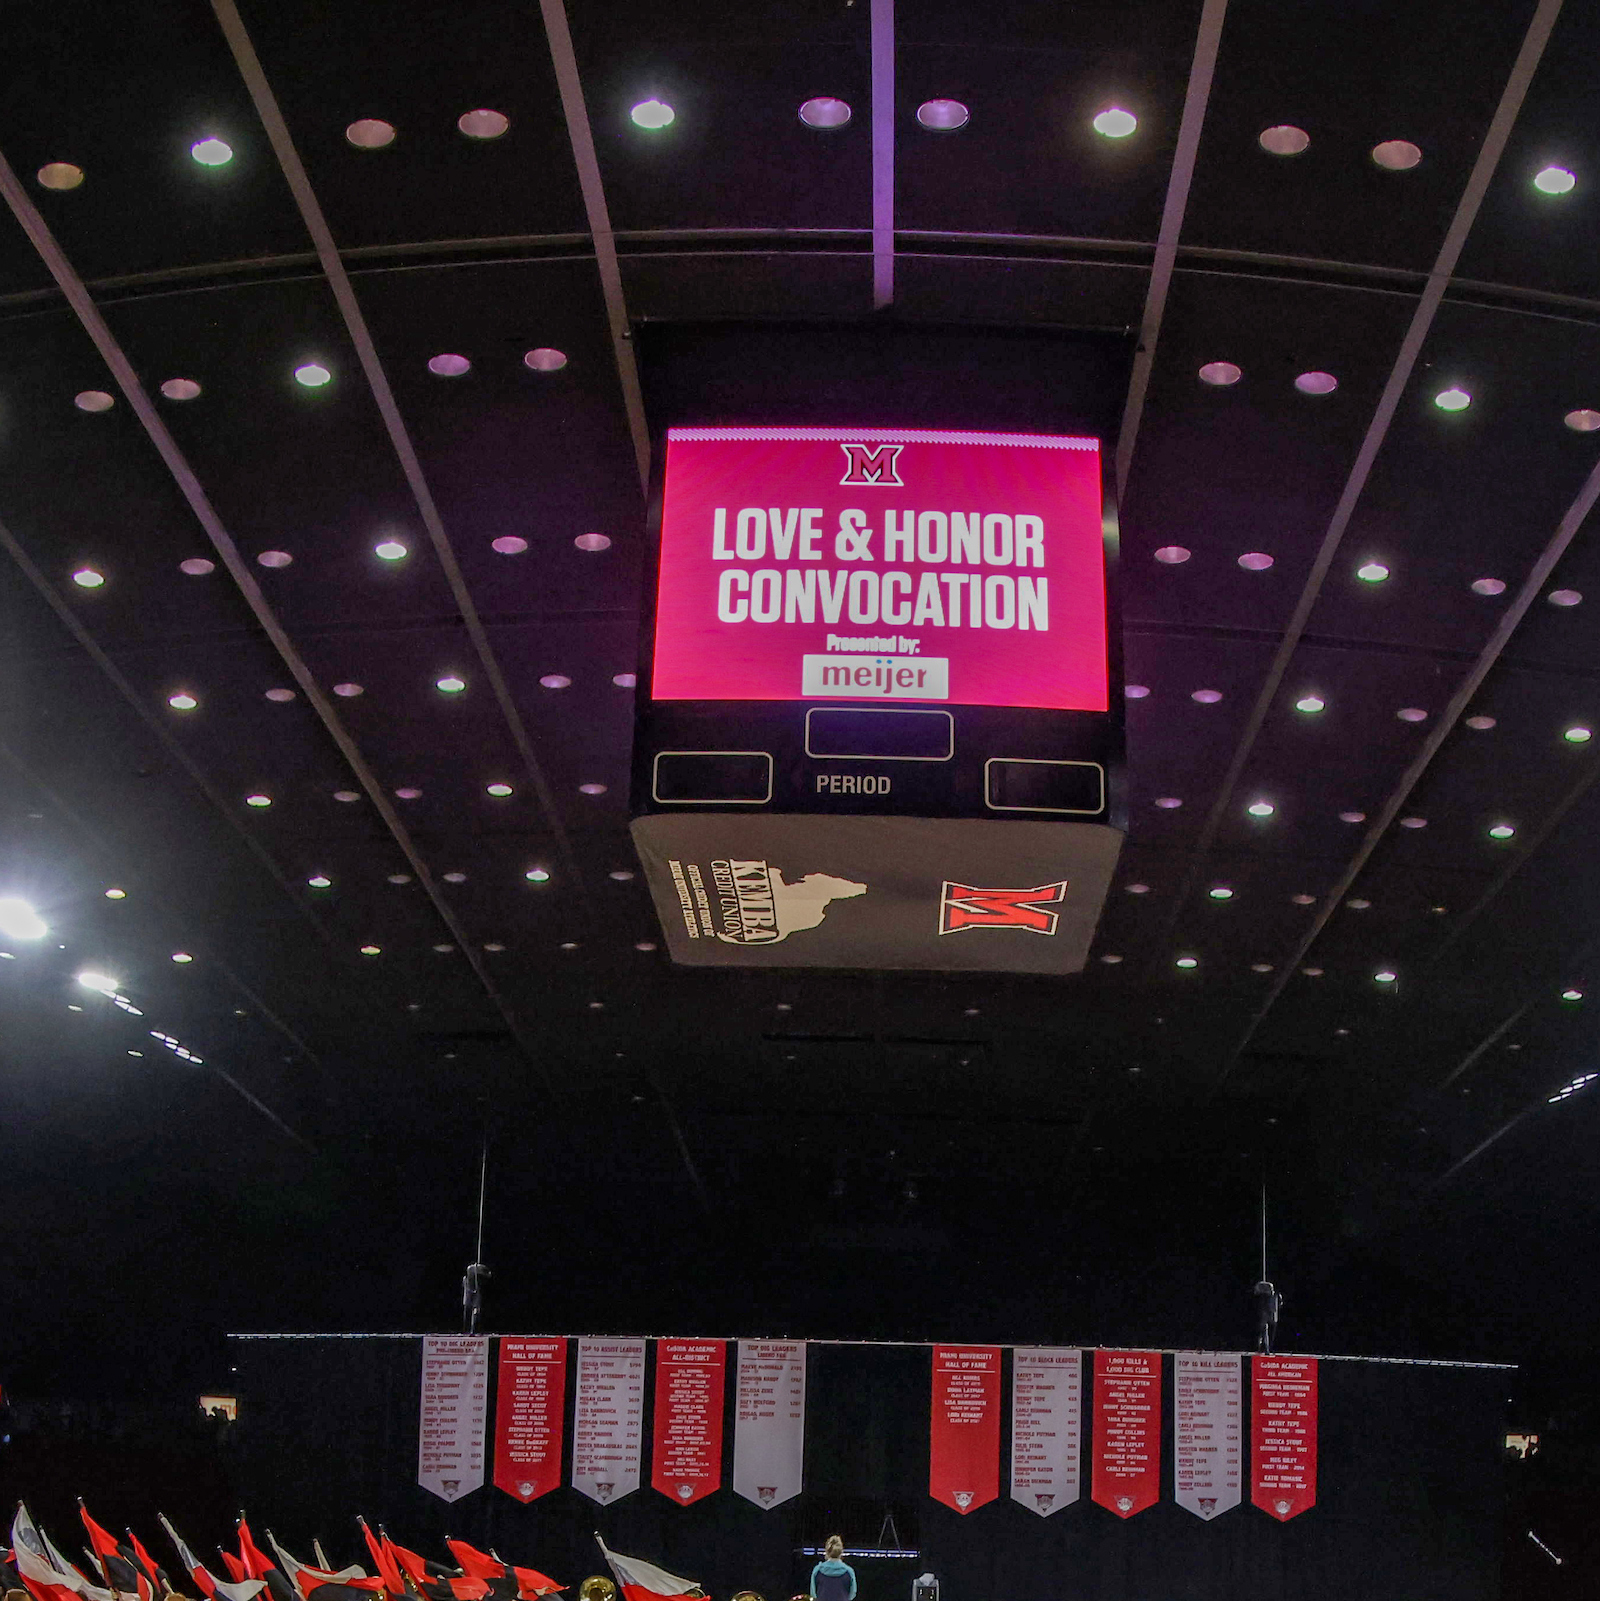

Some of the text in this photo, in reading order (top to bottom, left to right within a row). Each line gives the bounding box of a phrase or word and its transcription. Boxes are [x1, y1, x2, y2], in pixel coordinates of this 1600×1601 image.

[839, 443, 904, 486] M
[712, 507, 1045, 568] LOVE & HONOR
[717, 569, 1048, 631] CONVOCATION
[826, 633, 896, 653] Presented
[822, 659, 927, 695] meijer
[816, 775, 891, 795] PERIOD
[710, 860, 743, 938] CREDIT UNION
[729, 859, 778, 941] KEMBA
